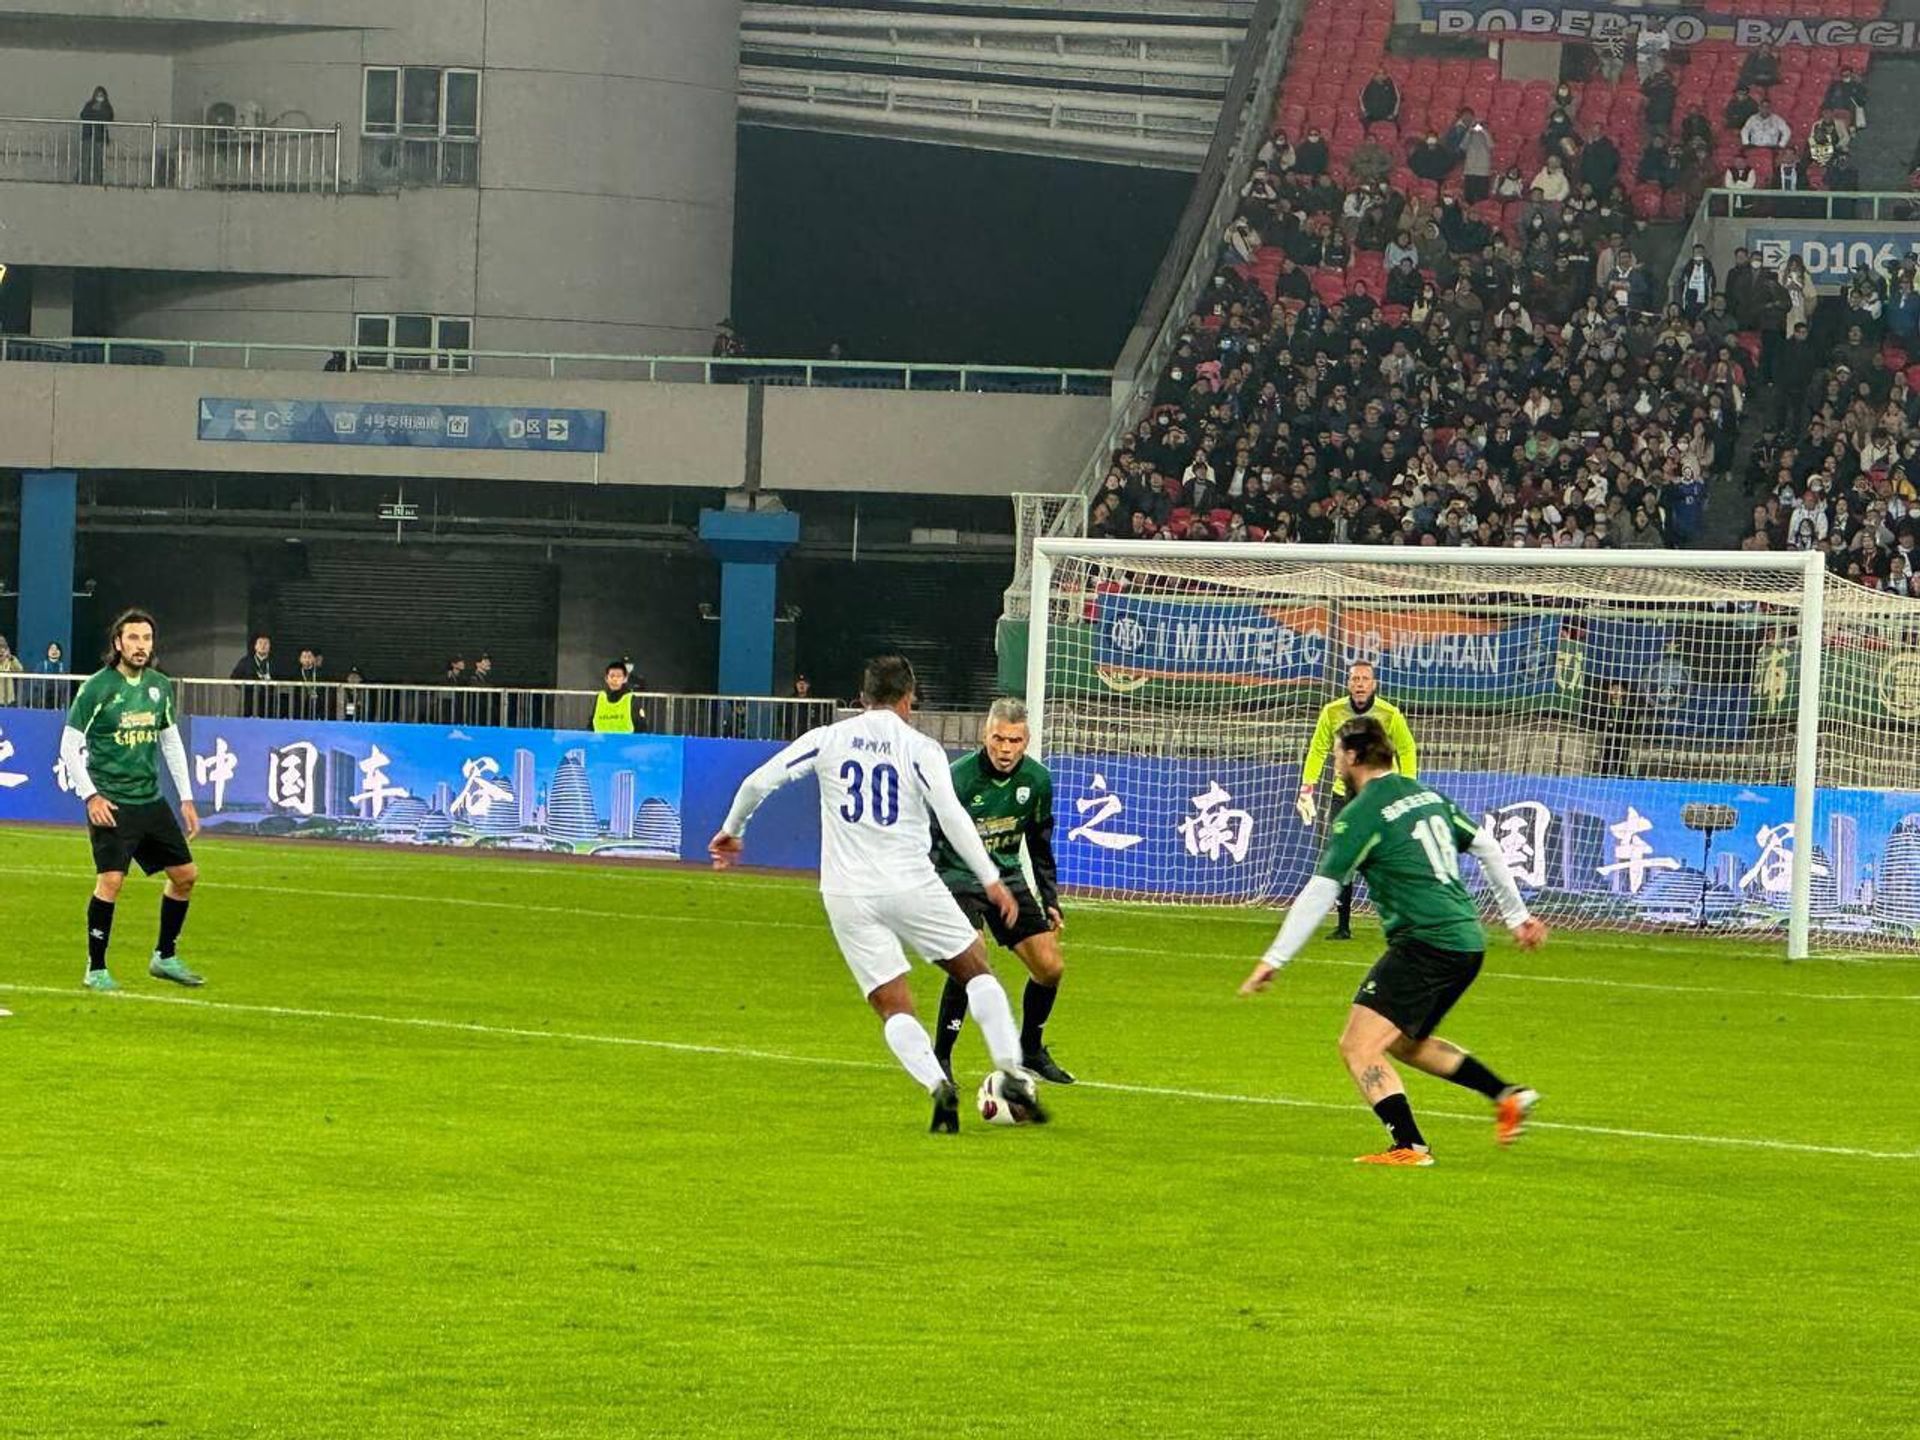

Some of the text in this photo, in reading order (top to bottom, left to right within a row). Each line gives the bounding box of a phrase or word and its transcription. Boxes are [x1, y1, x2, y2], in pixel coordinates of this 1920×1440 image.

[1735, 18, 1920, 48] BAGGI
[1205, 622, 1295, 665] INTER
[1302, 628, 1380, 668] CUB
[1391, 631, 1498, 674] WUHAN
[195, 737, 514, 816] 中国车谷
[840, 760, 899, 827] 30
[1068, 773, 1254, 862] 之南
